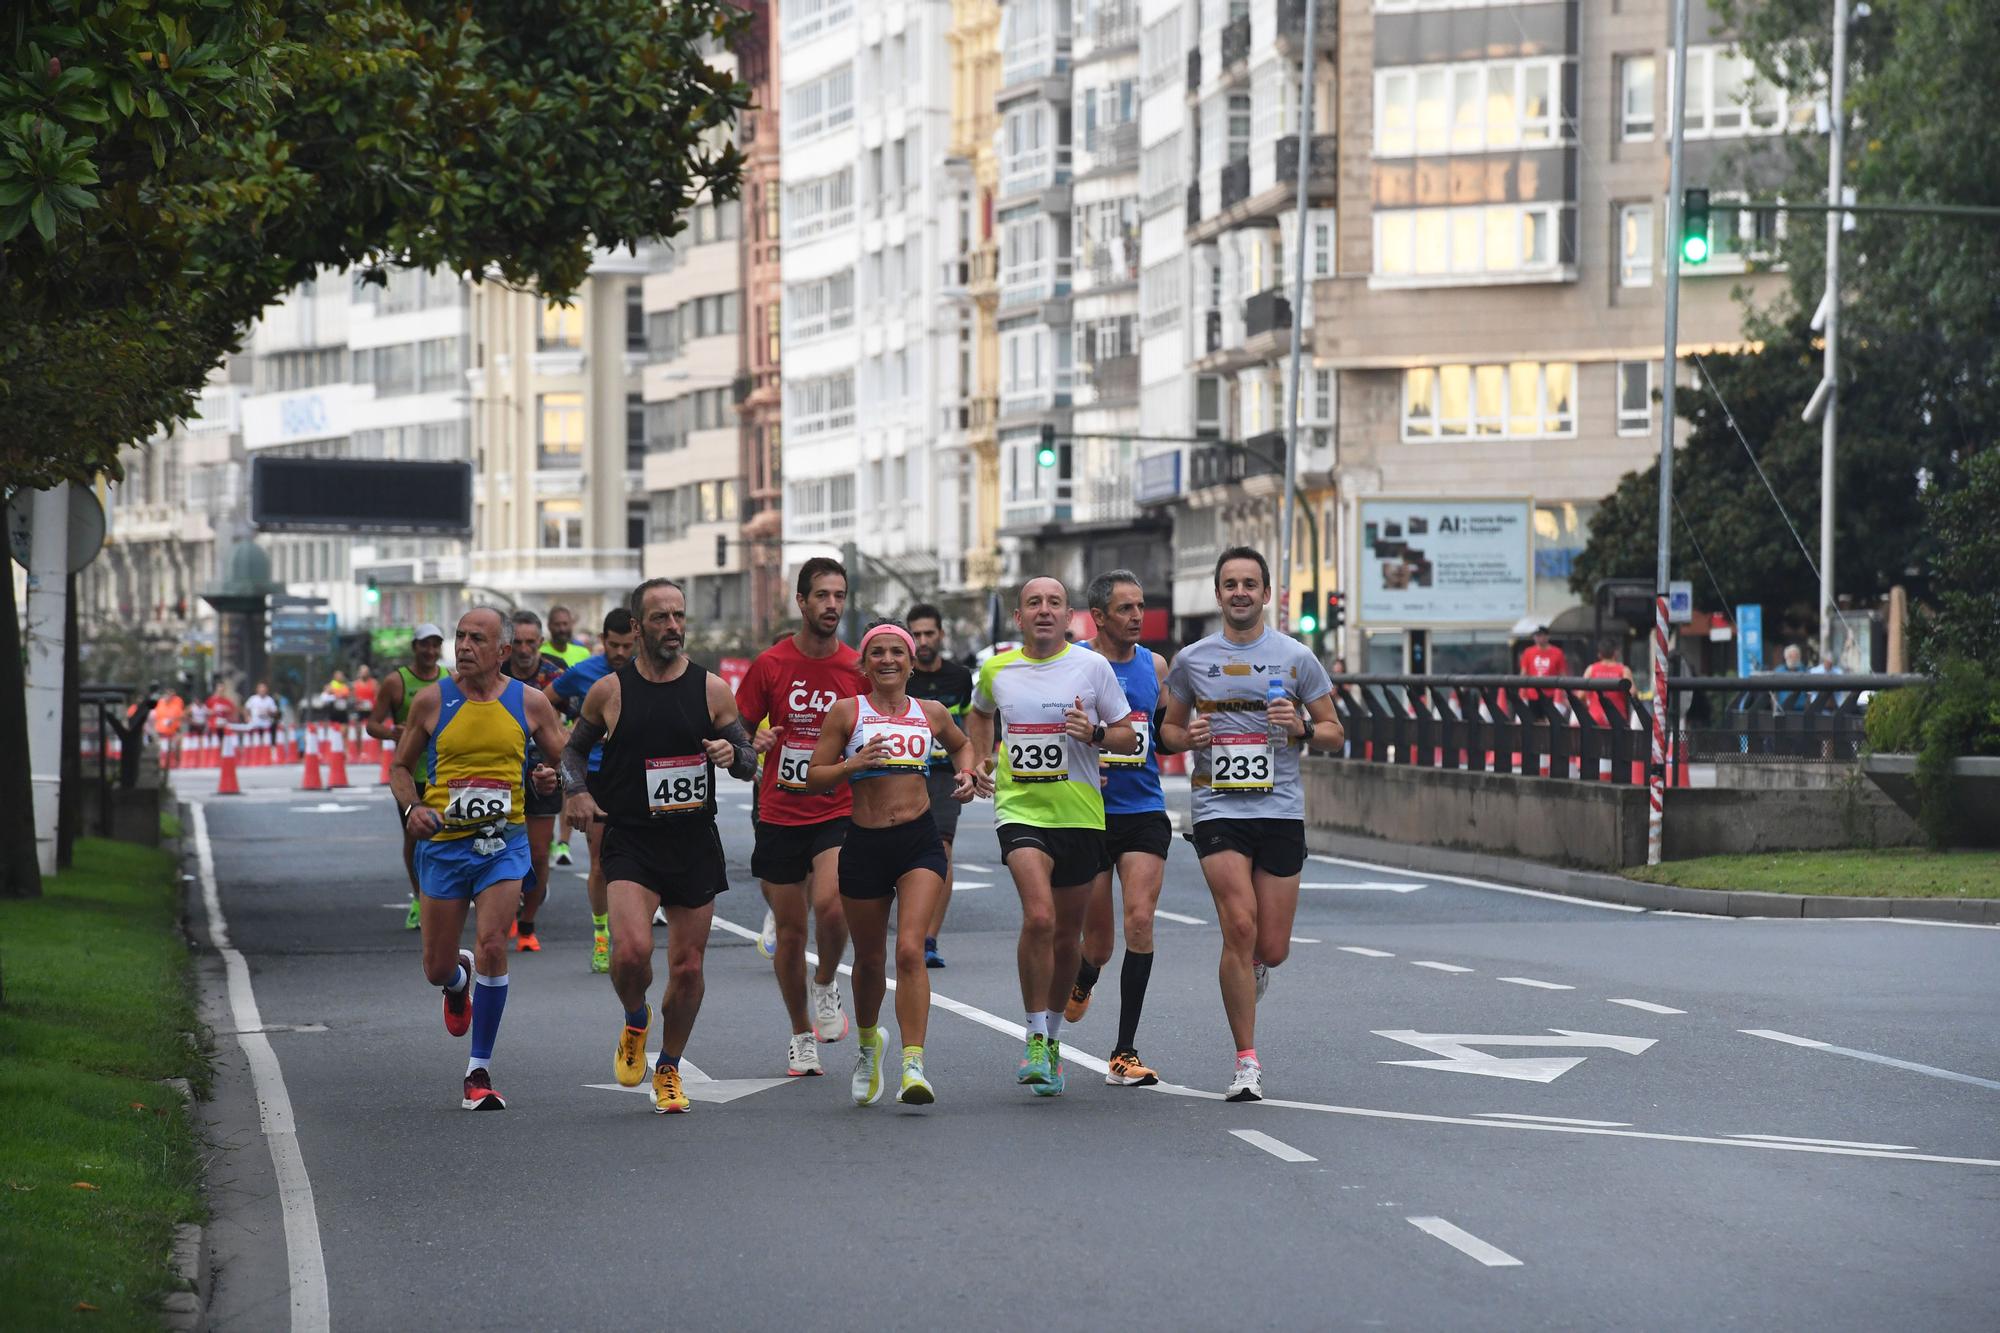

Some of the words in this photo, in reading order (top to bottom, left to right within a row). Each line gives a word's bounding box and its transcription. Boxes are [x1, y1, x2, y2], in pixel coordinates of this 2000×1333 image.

[876, 733, 926, 758] 30
[1010, 744, 1063, 769] 239
[781, 757, 810, 782] 50
[1215, 755, 1269, 781] 233
[653, 774, 707, 804] 485
[448, 796, 506, 820] 168
